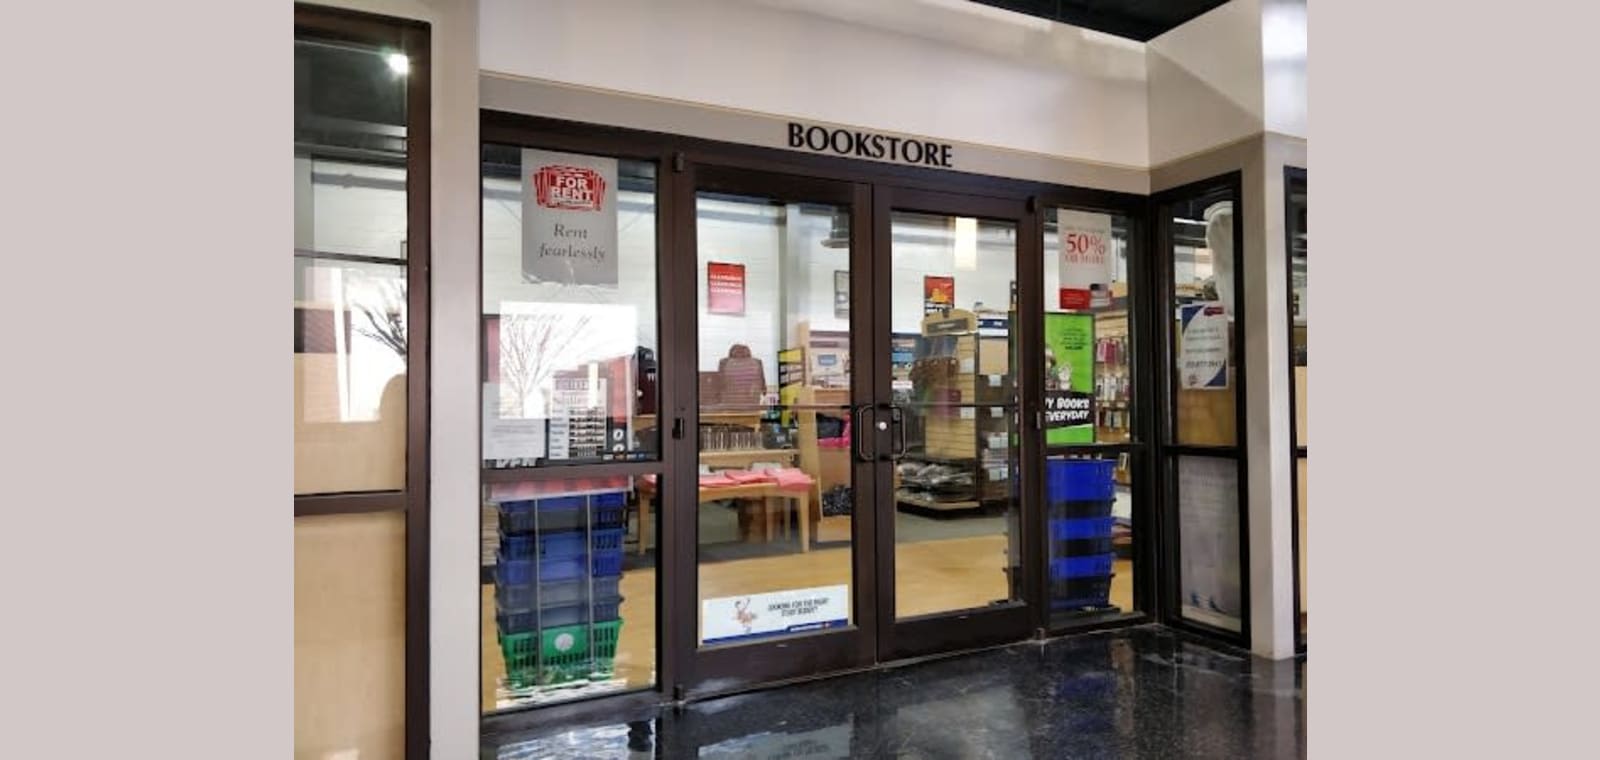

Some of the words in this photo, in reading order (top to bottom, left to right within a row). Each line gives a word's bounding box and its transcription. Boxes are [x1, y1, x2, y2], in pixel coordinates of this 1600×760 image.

[788, 122, 953, 168] BOOKSTORE
[556, 176, 588, 190] FOR
[551, 186, 593, 201] RENT
[554, 223, 588, 239] Rent
[538, 242, 606, 262] fearlessly
[1066, 233, 1106, 255] 50%
[1056, 397, 1090, 410] BOOKS
